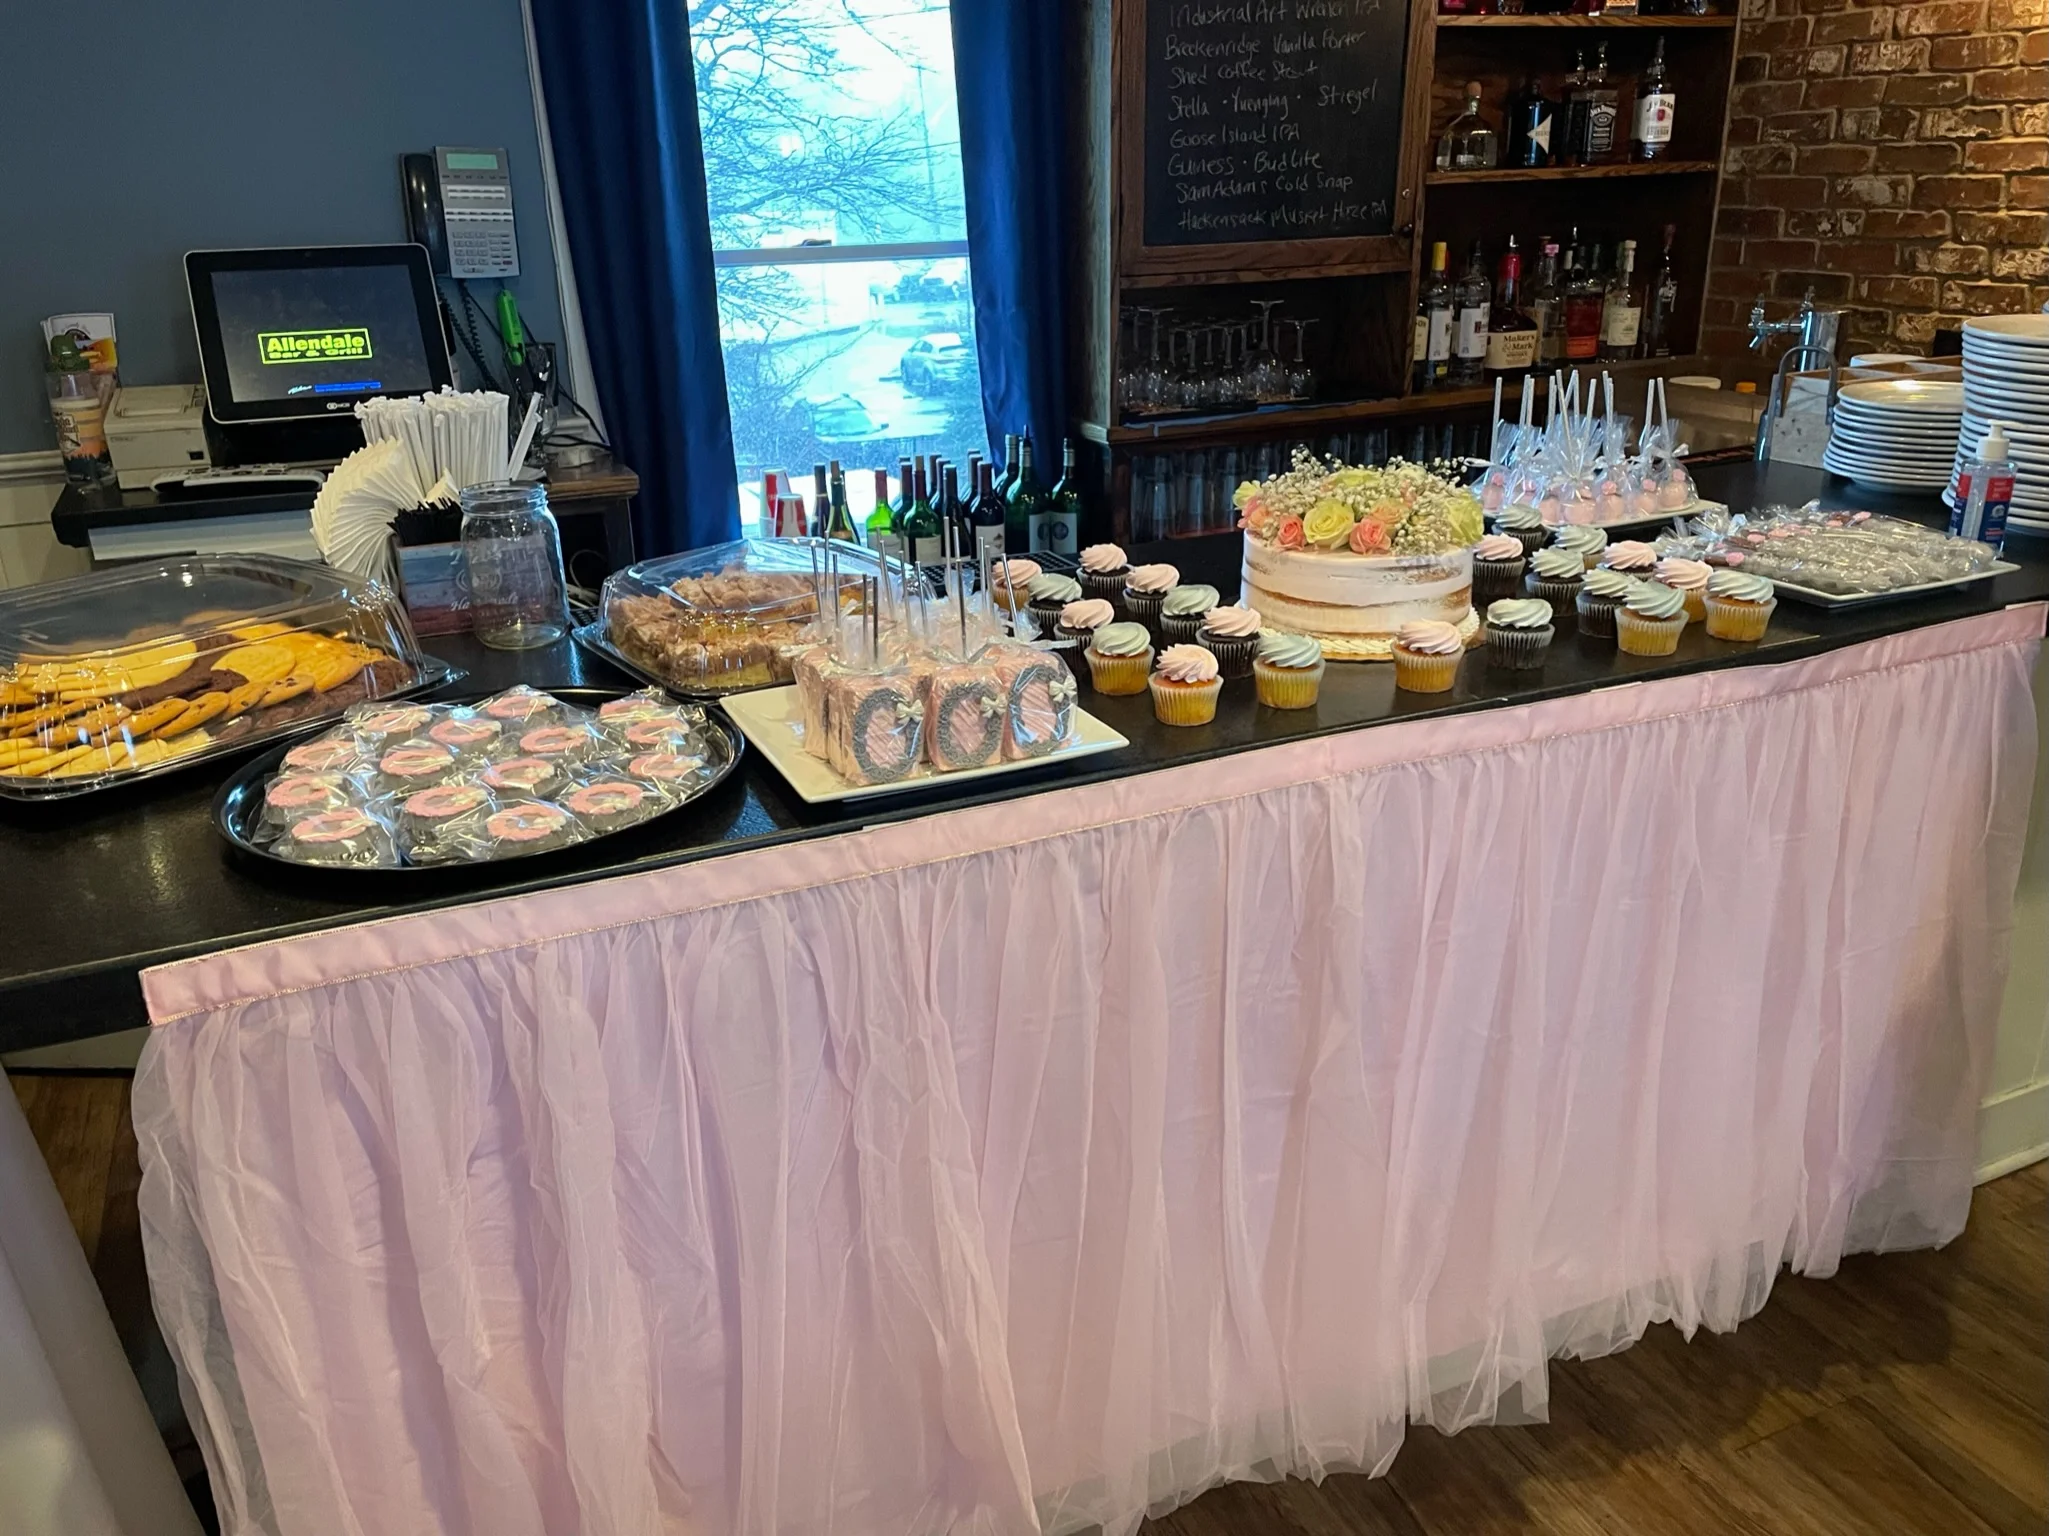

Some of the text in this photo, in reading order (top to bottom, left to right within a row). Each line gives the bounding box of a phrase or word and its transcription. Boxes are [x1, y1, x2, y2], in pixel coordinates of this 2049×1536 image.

[1273, 30, 1317, 54] Vanilla
[1322, 26, 1367, 49] Porter
[1167, 63, 1209, 89] Shed
[1168, 94, 1210, 121] Stella
[1169, 122, 1300, 149] Goose Island IPA
[1275, 173, 1309, 191] Cold
[1317, 171, 1354, 192] Snap
[267, 333, 366, 353] Allendale
[268, 349, 302, 360] Bar
[325, 345, 364, 357] Grill
